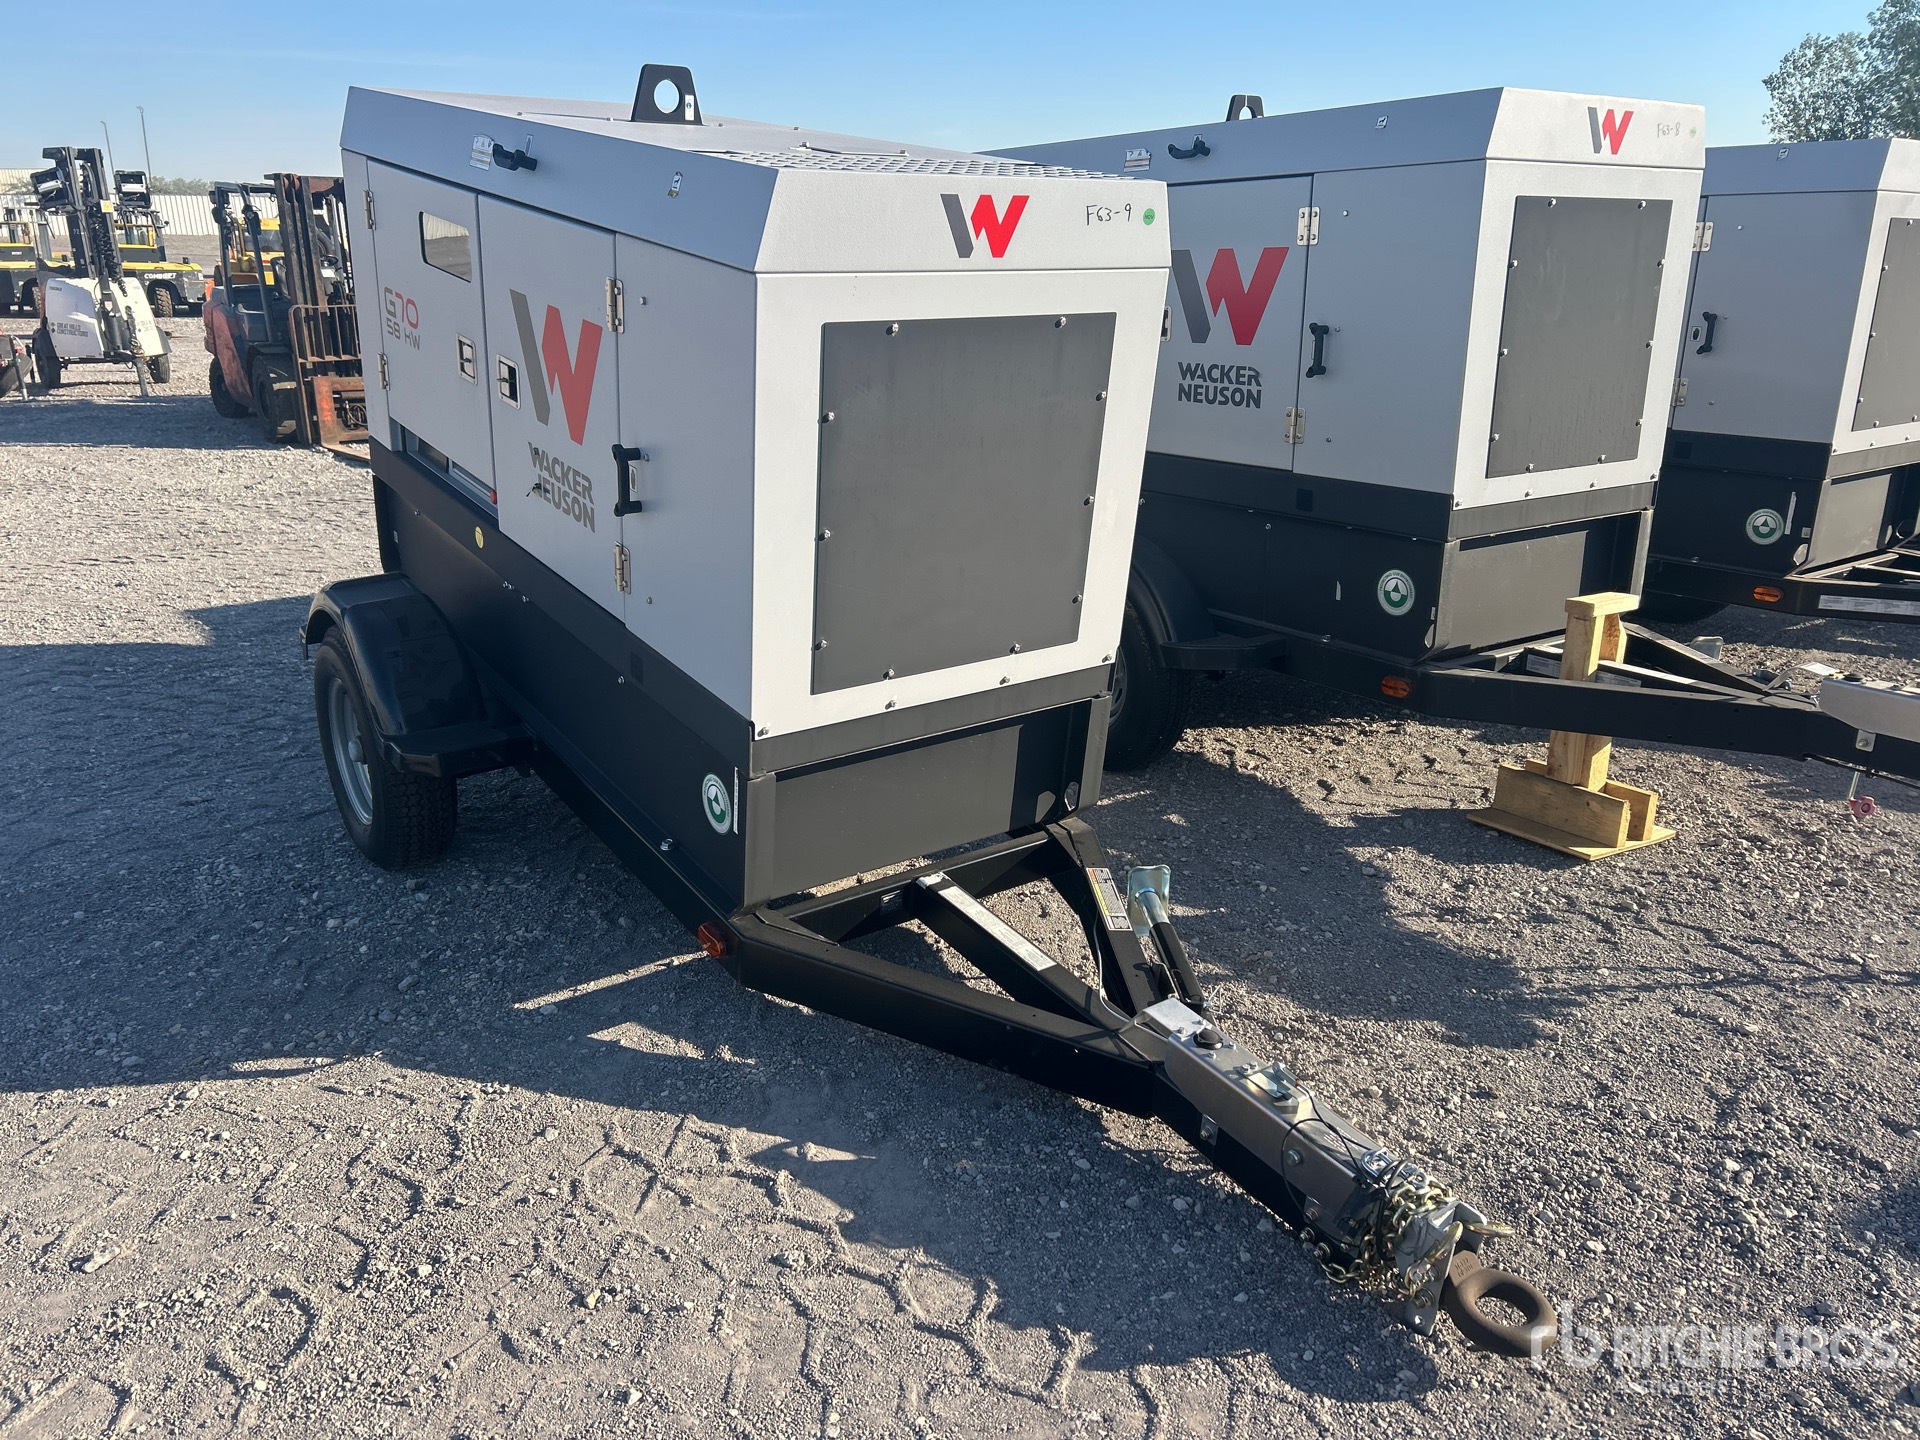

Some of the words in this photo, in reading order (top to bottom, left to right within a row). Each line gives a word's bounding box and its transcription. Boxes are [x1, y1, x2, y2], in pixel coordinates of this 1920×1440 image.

[1657, 121, 1681, 138] F63-8
[1086, 202, 1132, 226] F63-9
[384, 286, 419, 330] G70
[386, 316, 401, 340] 58
[1177, 361, 1263, 387] WACKER
[1177, 382, 1263, 410] NEUSON
[528, 441, 595, 506] WACKER
